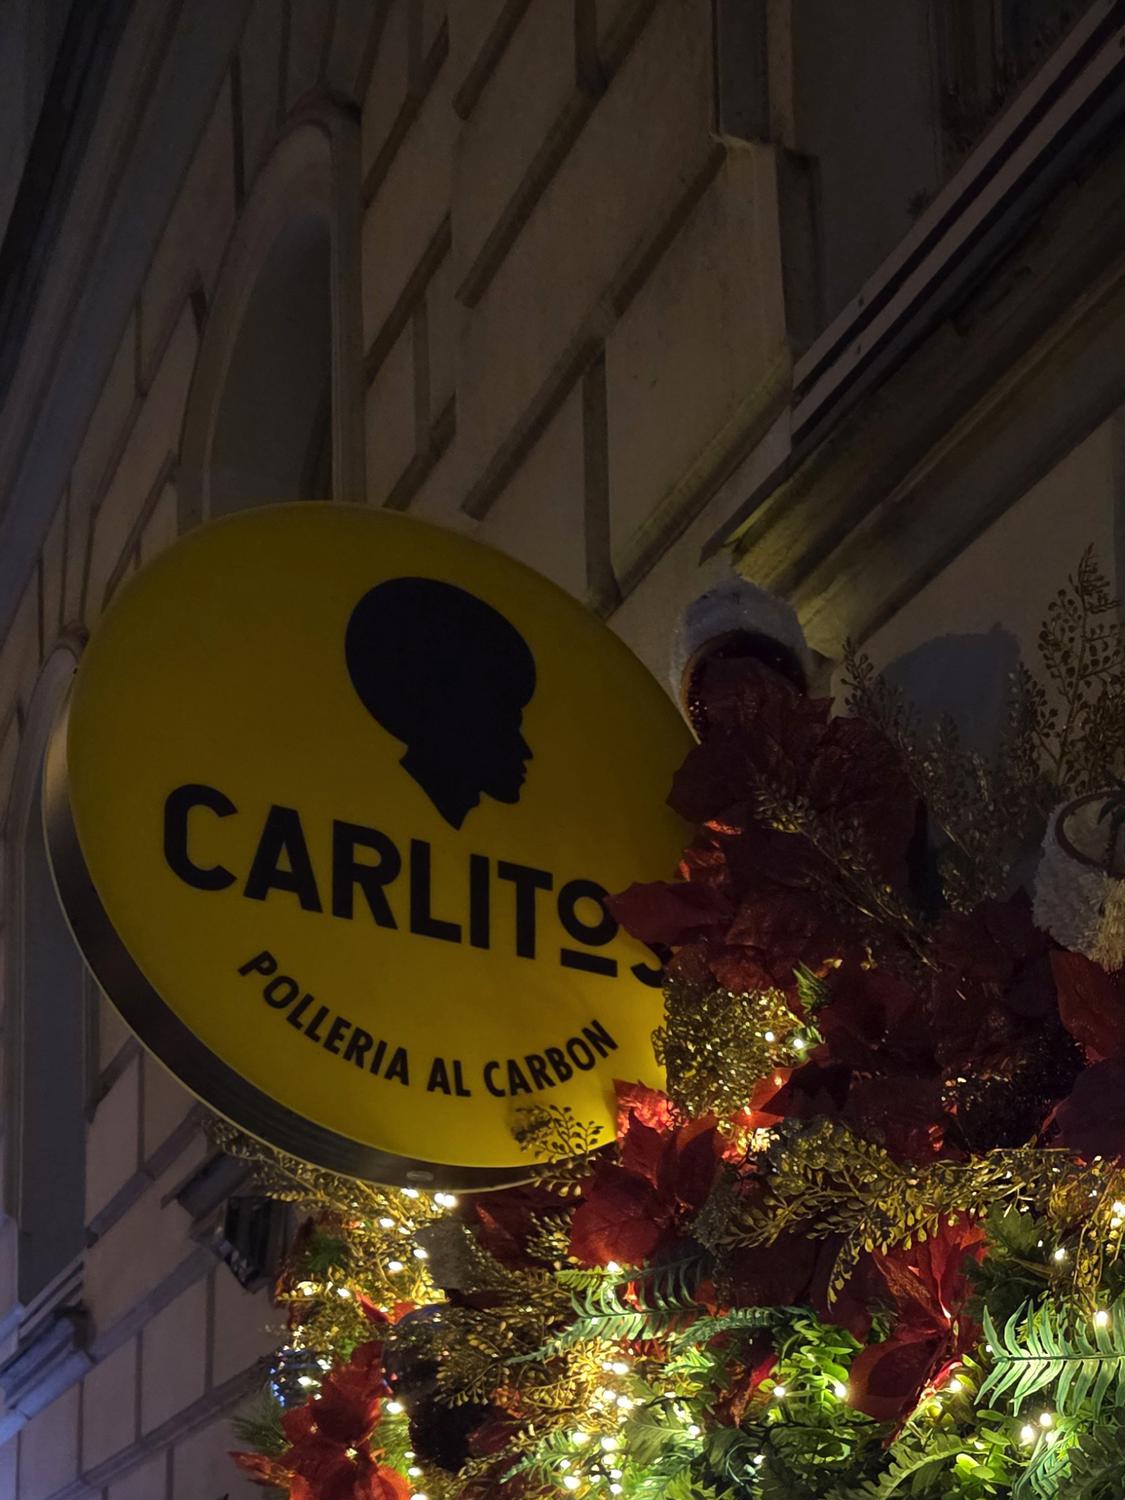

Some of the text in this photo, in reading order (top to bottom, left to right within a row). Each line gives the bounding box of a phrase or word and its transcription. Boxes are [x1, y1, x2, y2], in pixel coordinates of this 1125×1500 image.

[238, 950, 618, 1097] POLLERIA AL CARBON
